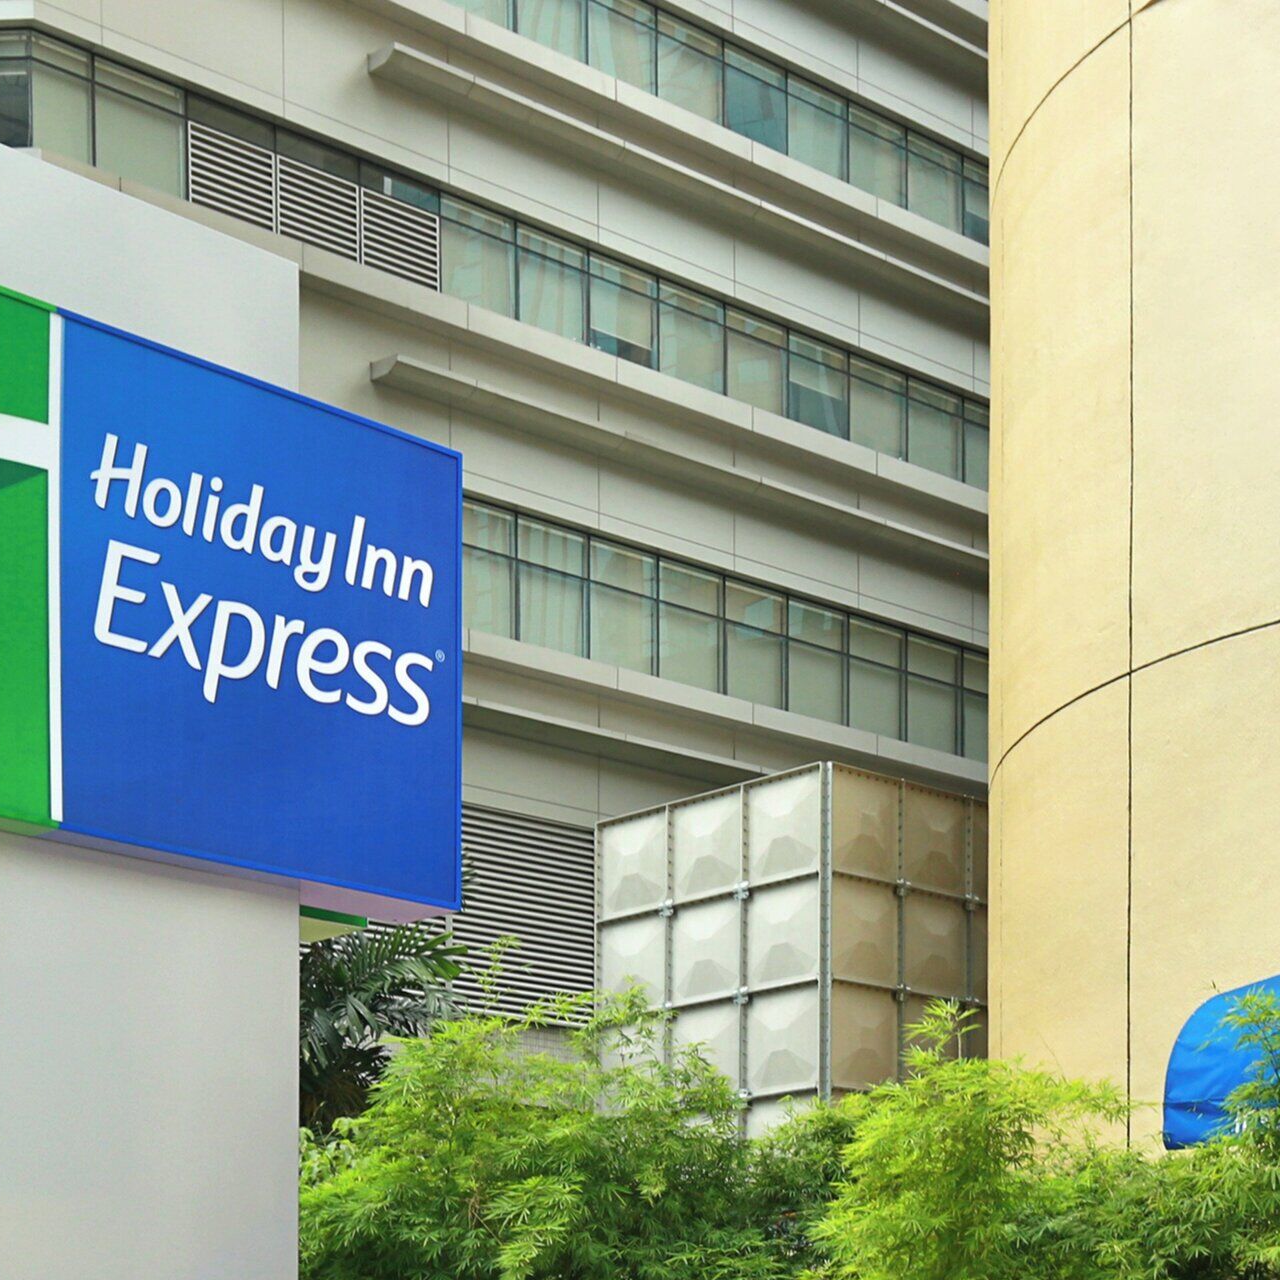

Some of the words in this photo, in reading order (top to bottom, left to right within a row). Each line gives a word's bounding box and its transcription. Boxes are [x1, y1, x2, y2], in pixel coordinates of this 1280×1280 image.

[90, 432, 337, 592] Holiday
[344, 515, 435, 608] Inn
[93, 538, 434, 727] Express
